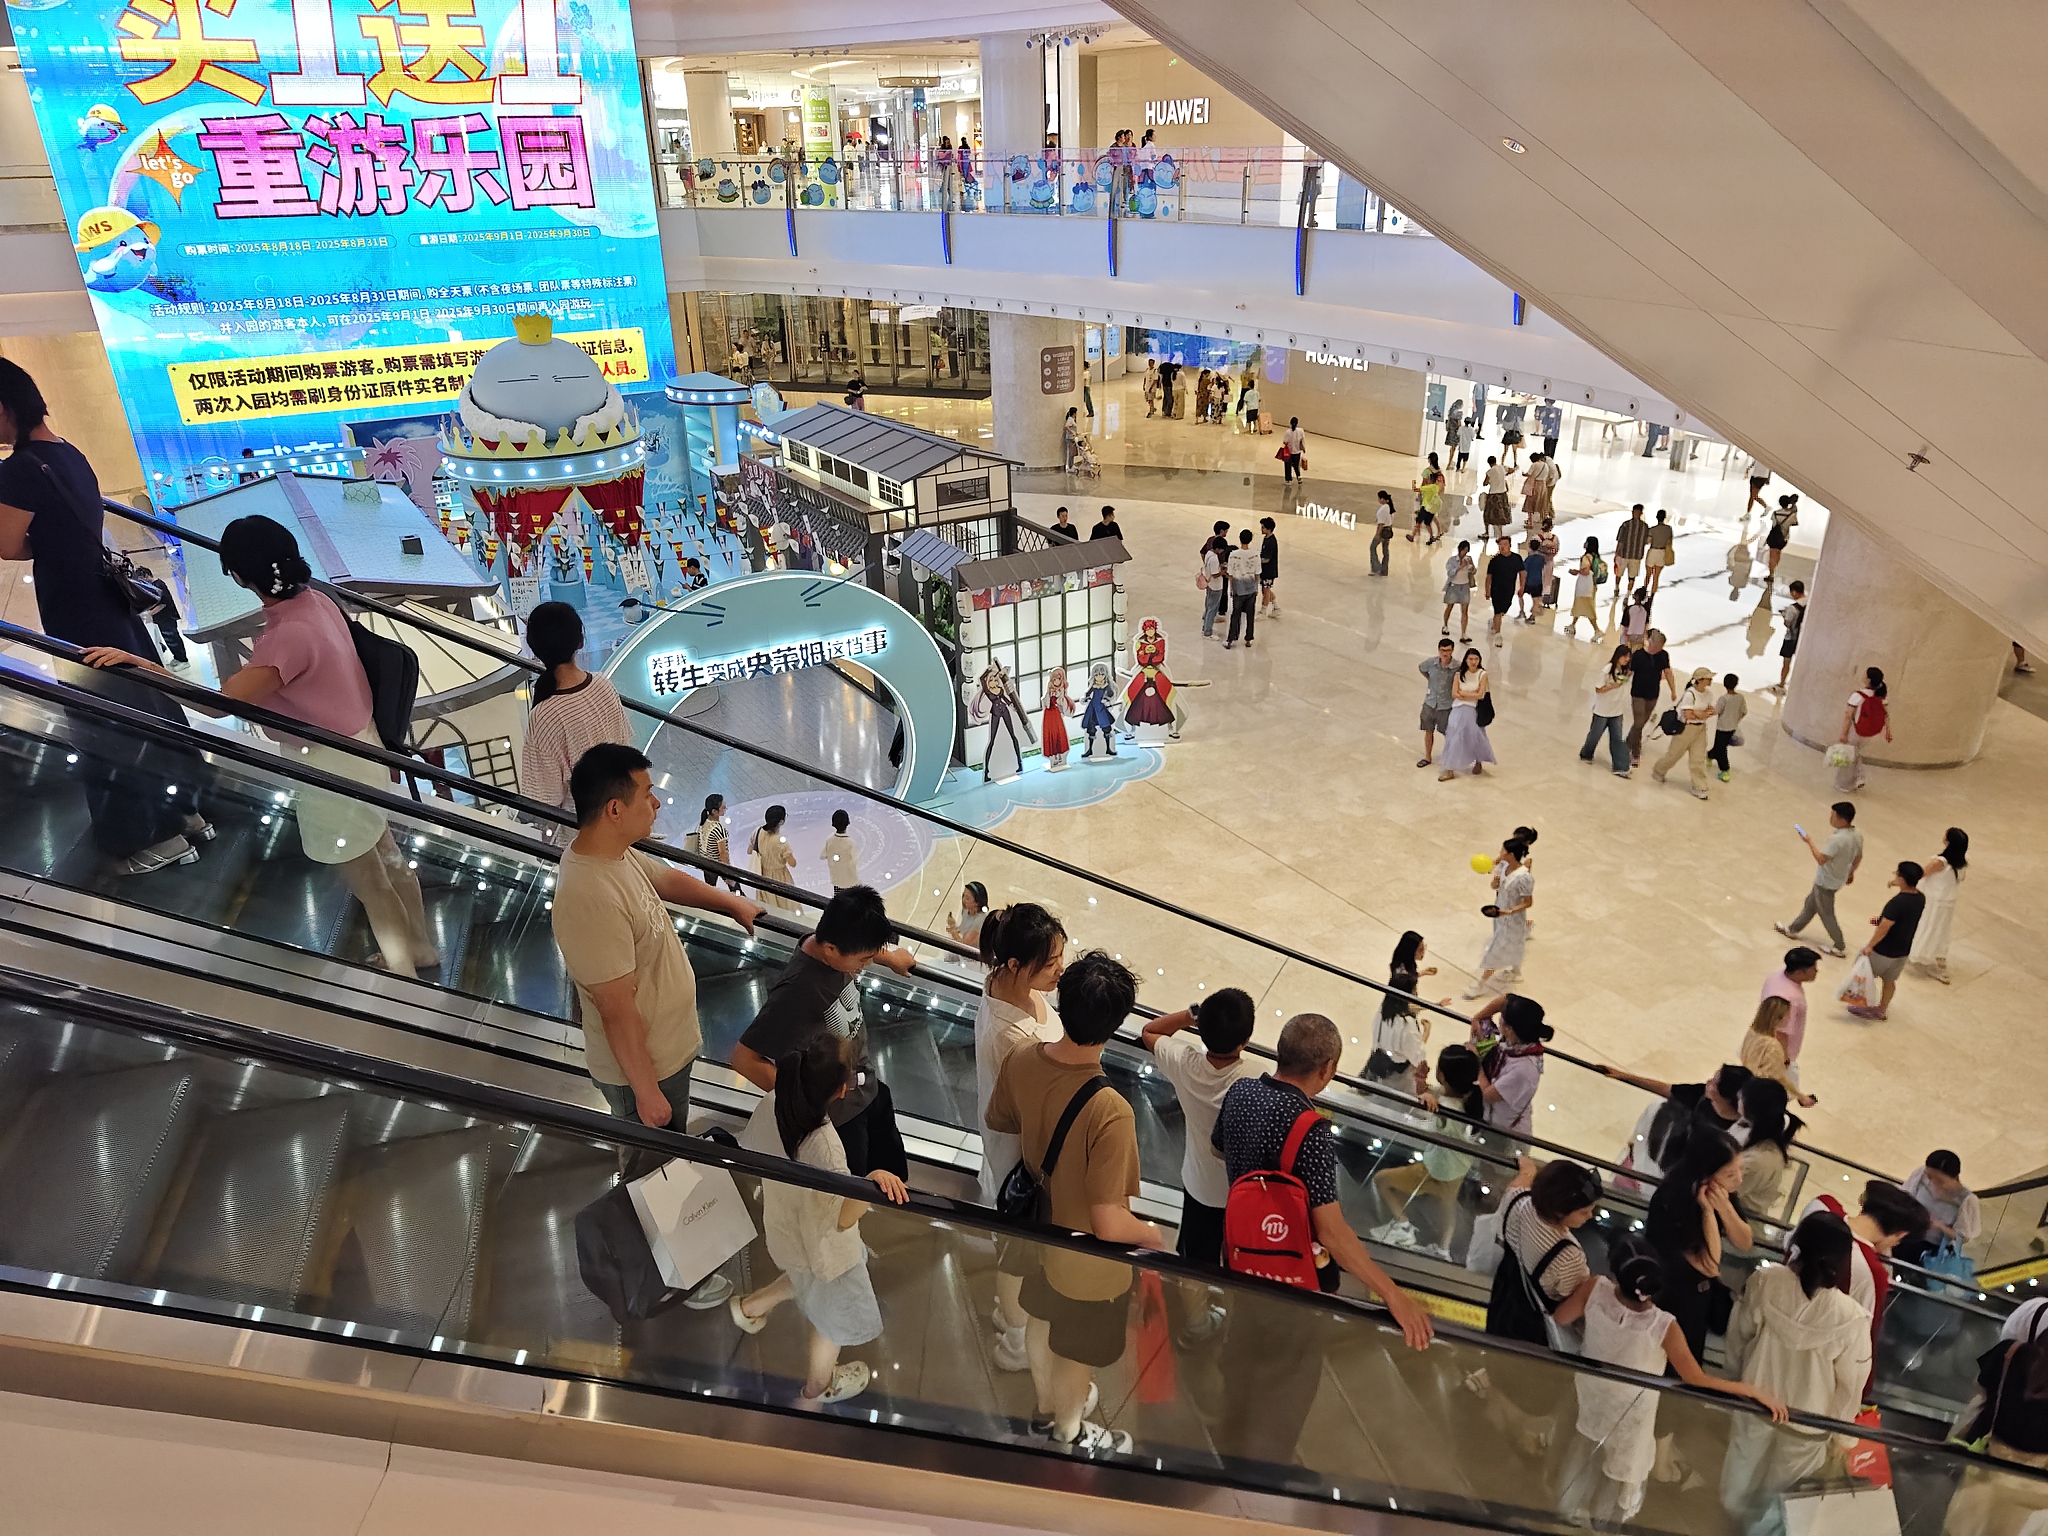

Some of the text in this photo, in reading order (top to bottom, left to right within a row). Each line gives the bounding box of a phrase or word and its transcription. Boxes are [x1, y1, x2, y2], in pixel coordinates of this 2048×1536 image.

[115, 0, 583, 109] 买1送1
[1145, 97, 1210, 126] HUAWEI
[140, 154, 183, 171] let's
[197, 111, 596, 218] 重游乐园
[170, 172, 195, 188] go
[1305, 350, 1369, 372] HUAWEI
[193, 373, 474, 416] 两次入园均需刷身份证原件实名制
[653, 628, 888, 696] 转生变成史莱姆这档事
[683, 1209, 704, 1226] Calvin
